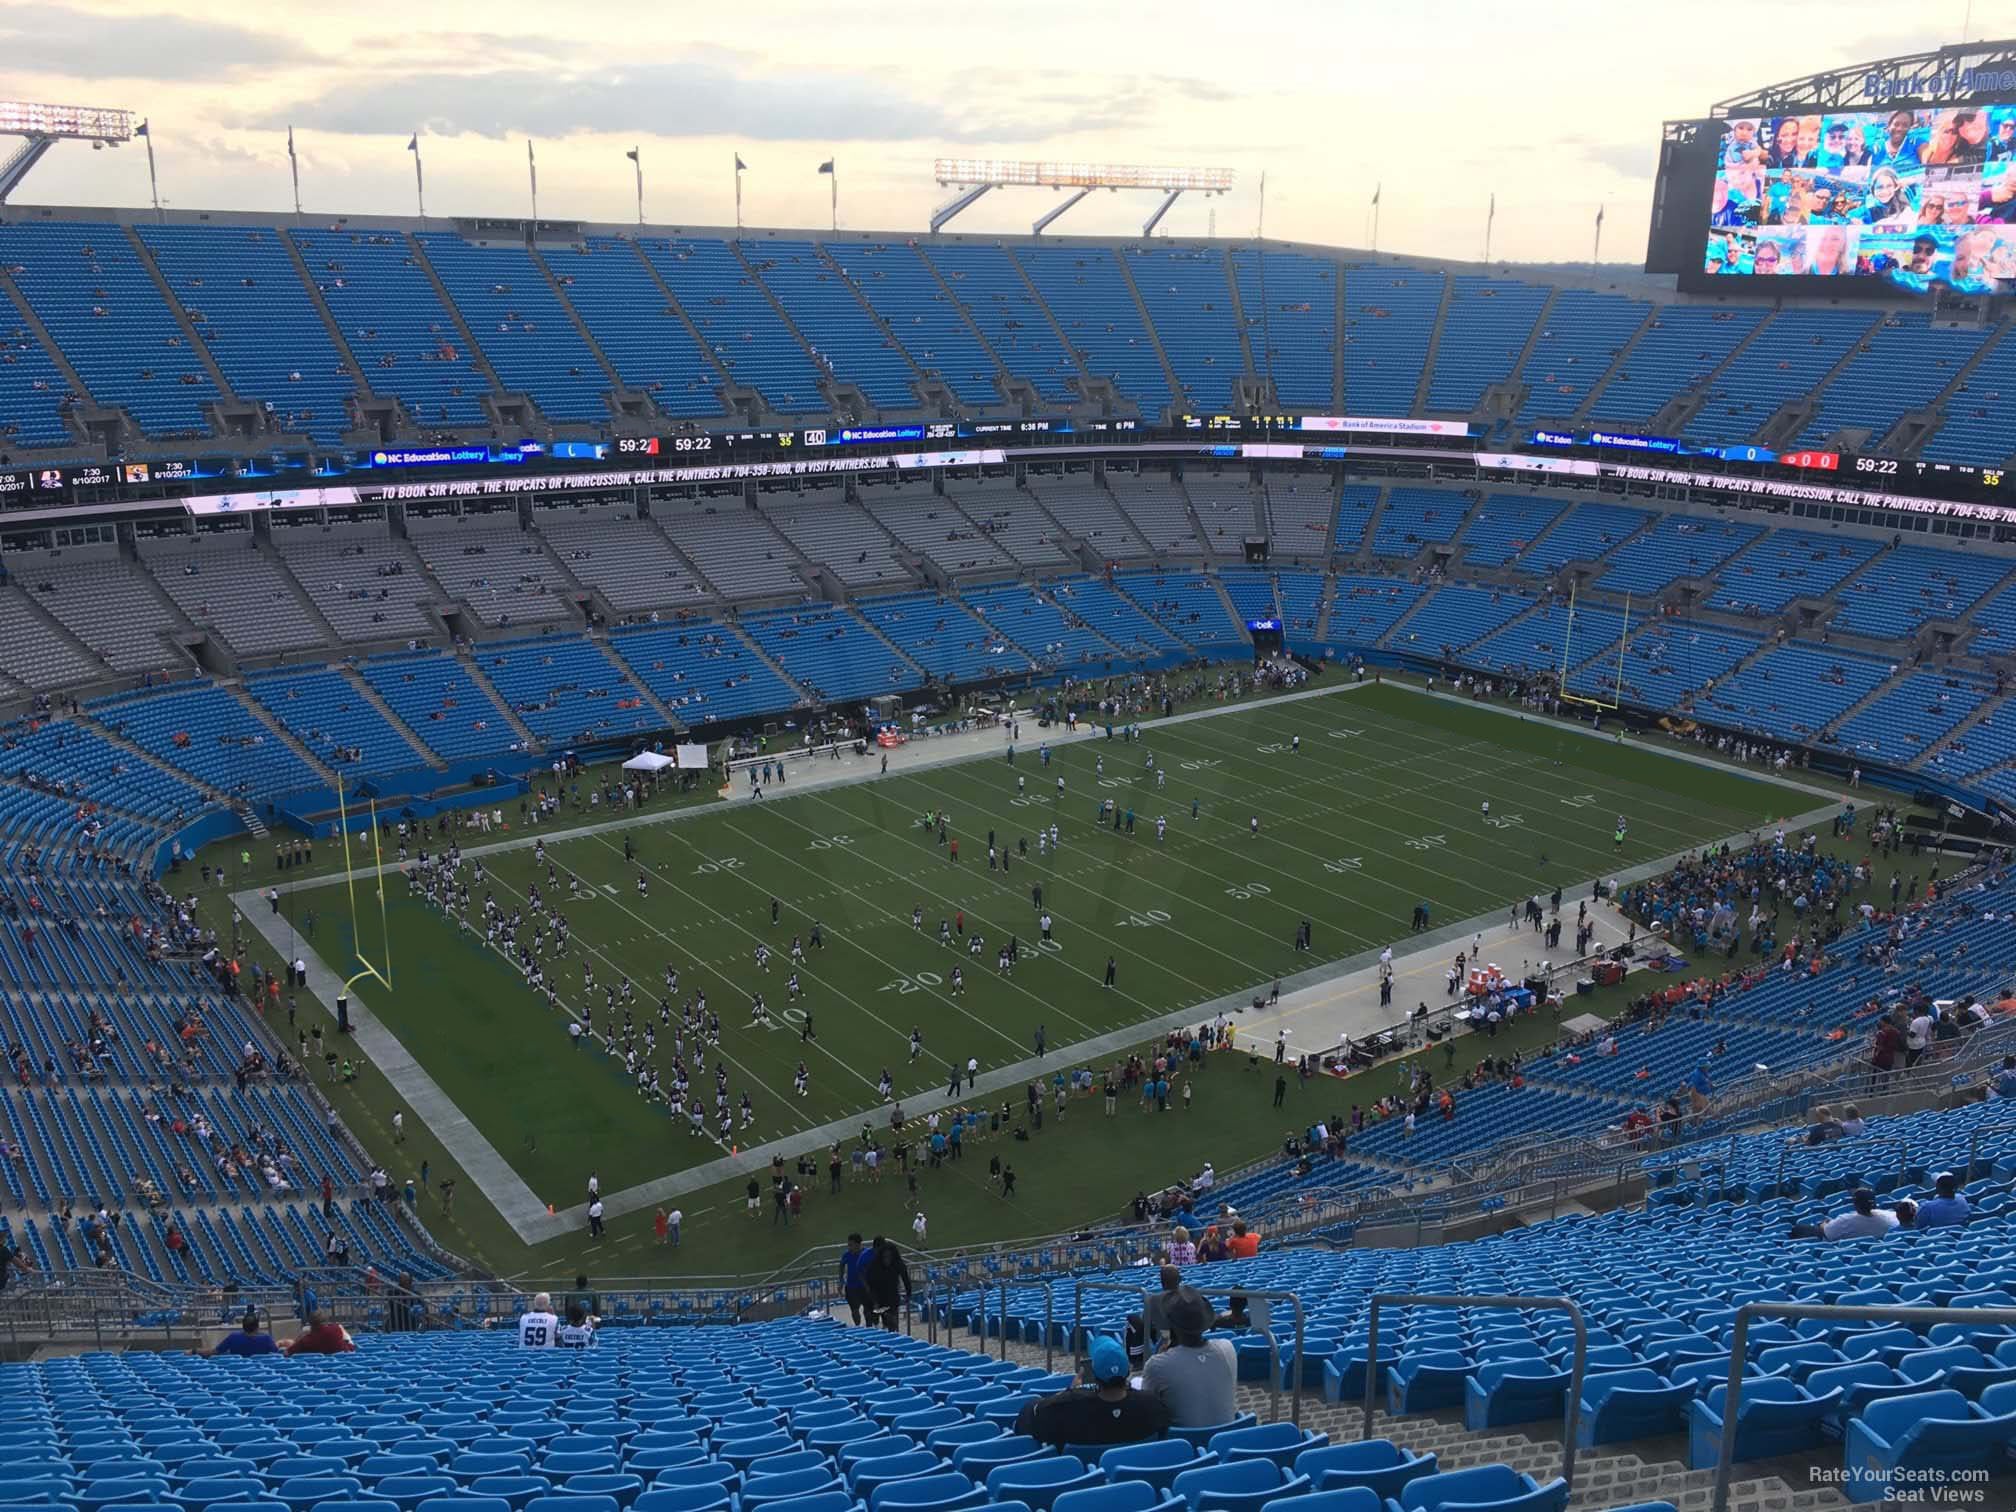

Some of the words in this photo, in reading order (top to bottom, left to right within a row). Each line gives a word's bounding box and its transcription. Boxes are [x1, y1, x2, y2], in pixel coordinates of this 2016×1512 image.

[1863, 72, 1925, 97] Bank
[1928, 69, 1956, 94] of
[1957, 68, 2016, 92] Ame
[807, 432, 823, 444] 40
[851, 431, 862, 439] NC
[863, 430, 896, 439] Education
[897, 429, 921, 439] Lottery
[675, 438, 712, 452] 59:22
[779, 437, 792, 447] 35
[1601, 436, 1613, 445] NC
[1613, 437, 1648, 447] Education
[1649, 440, 1677, 451] Lottery
[388, 454, 402, 463] NC
[404, 452, 451, 463] Education
[452, 450, 485, 462] Lottery
[82, 467, 101, 476] 7:30
[166, 462, 183, 471] 7:30
[1855, 458, 1898, 474] 59:22
[155, 469, 192, 479] 8/10/2017
[397, 485, 426, 499] BOOK
[429, 485, 447, 498] SIR
[449, 482, 481, 497] PURR,
[483, 481, 502, 494] THE
[504, 478, 547, 493] TOPCATS
[549, 478, 562, 490] OR
[563, 474, 632, 489] PURRCUSSION,
[634, 471, 656, 485] CALL
[657, 470, 674, 483] THE
[675, 467, 721, 482] PANTHERS
[721, 466, 733, 479] AT
[795, 462, 807, 474] OR
[808, 461, 830, 474] VISIT
[1983, 474, 1999, 485] 35
[72, 475, 111, 486] 8/10/2017
[1627, 468, 1649, 480] BOOK
[1649, 470, 1665, 482] SIR
[1694, 475, 1712, 487] THE
[1712, 477, 1751, 493] TOPCATS
[1751, 481, 1766, 494] OR
[1836, 491, 1863, 505] CALL
[1863, 495, 1882, 508] THE
[1882, 497, 1935, 514] PANTHERS
[1936, 502, 1952, 515] AT
[524, 1326, 547, 1346] 59
